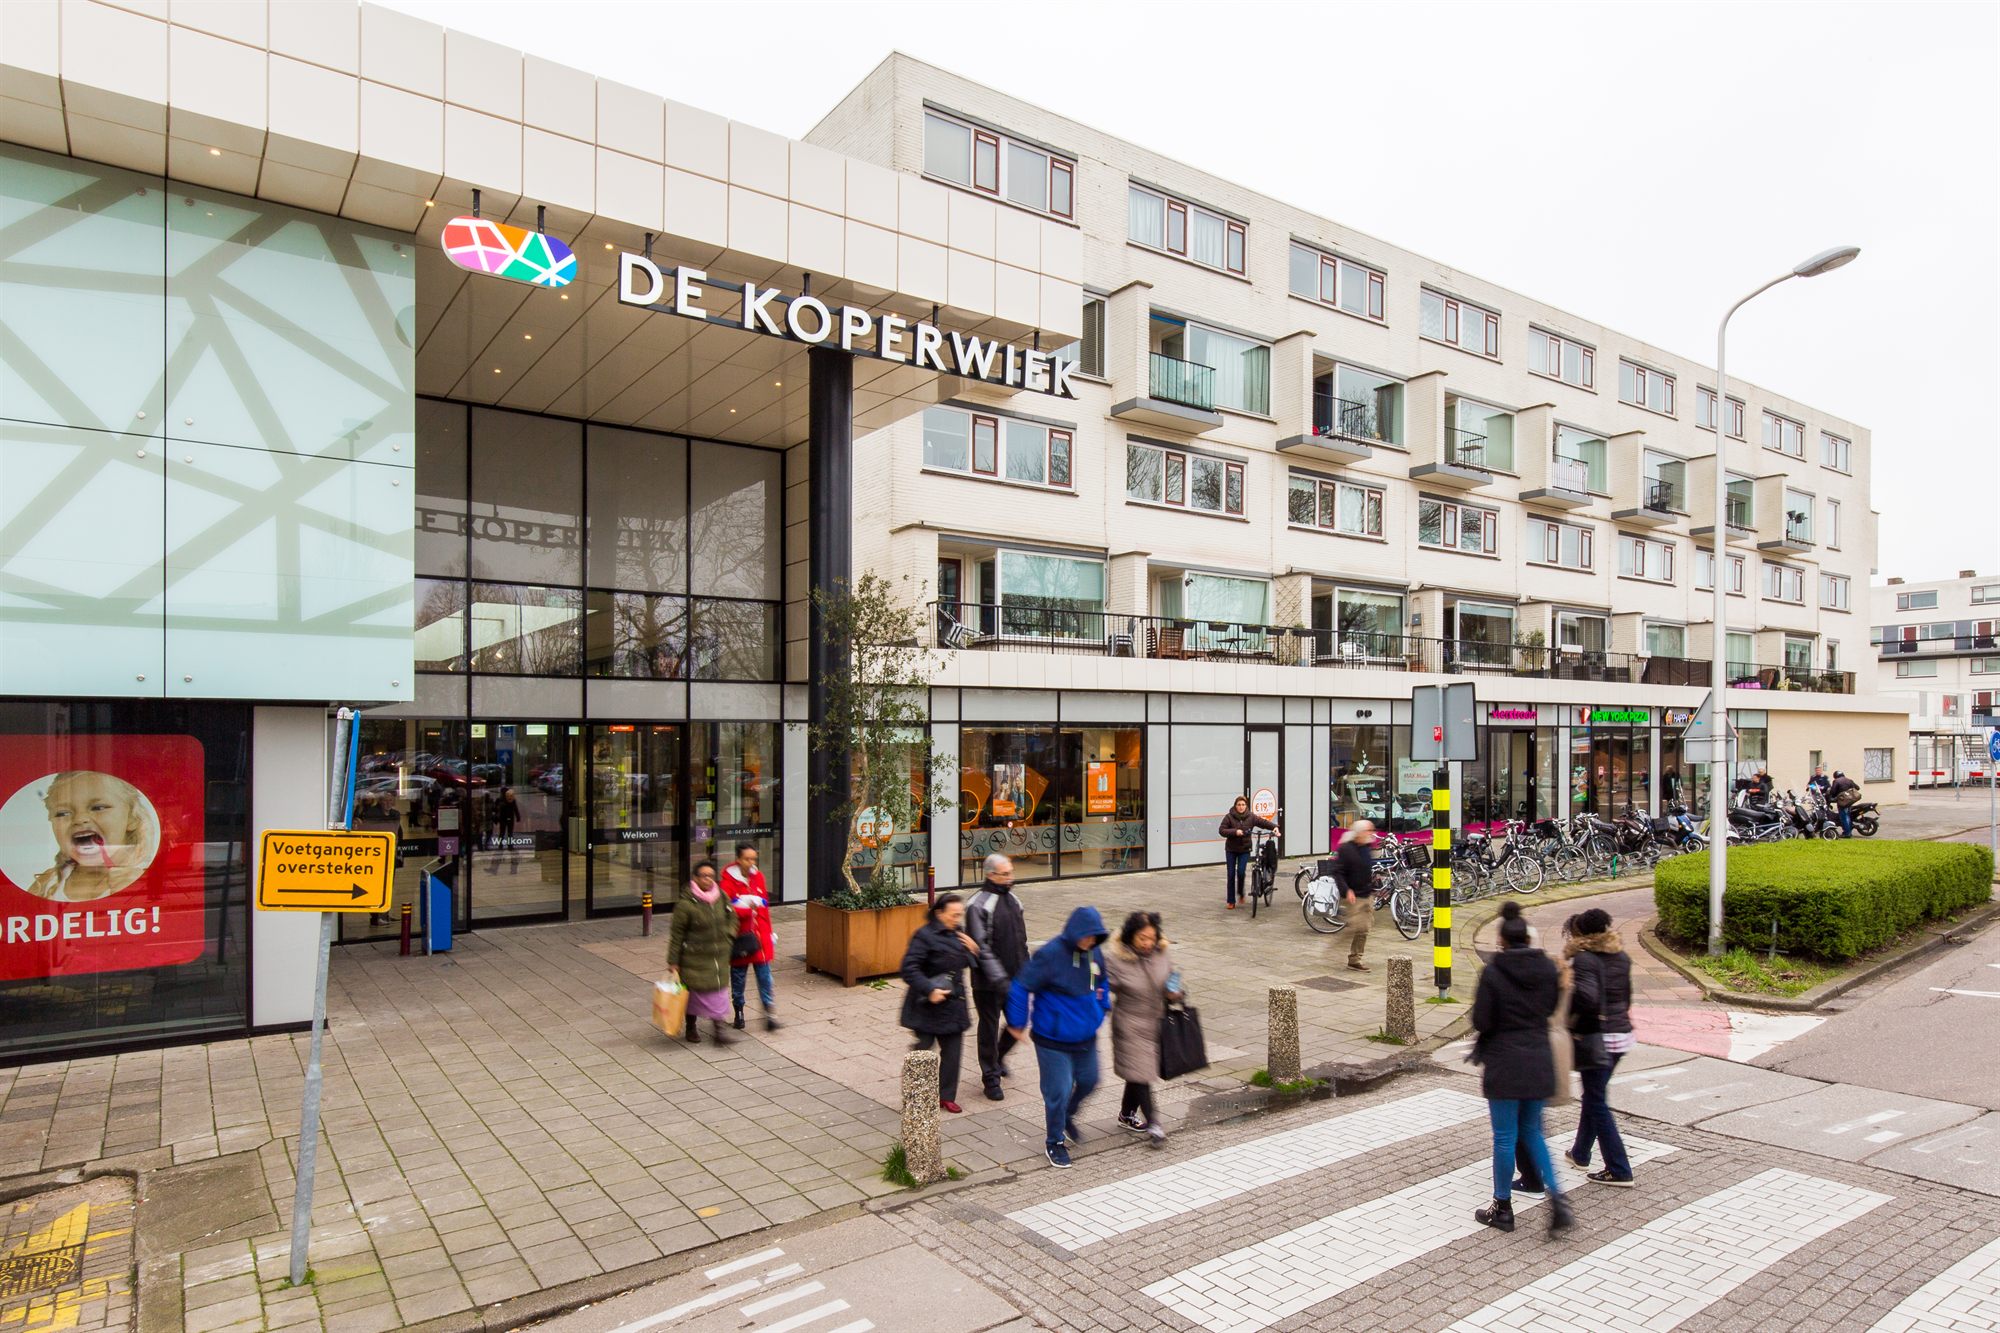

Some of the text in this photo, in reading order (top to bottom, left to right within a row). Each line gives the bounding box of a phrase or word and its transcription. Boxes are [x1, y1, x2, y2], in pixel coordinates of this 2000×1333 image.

[618, 251, 1081, 400] DE KOPERWIEK
[1592, 712, 1648, 722] NEW YORK PIZZA
[1674, 713, 1688, 723] HAPPY
[622, 830, 659, 840] Welkom
[491, 836, 533, 847] Welkom
[273, 842, 381, 860] Voetgangers
[277, 862, 374, 875] oversteken
[0, 906, 161, 944] RDELIG!
